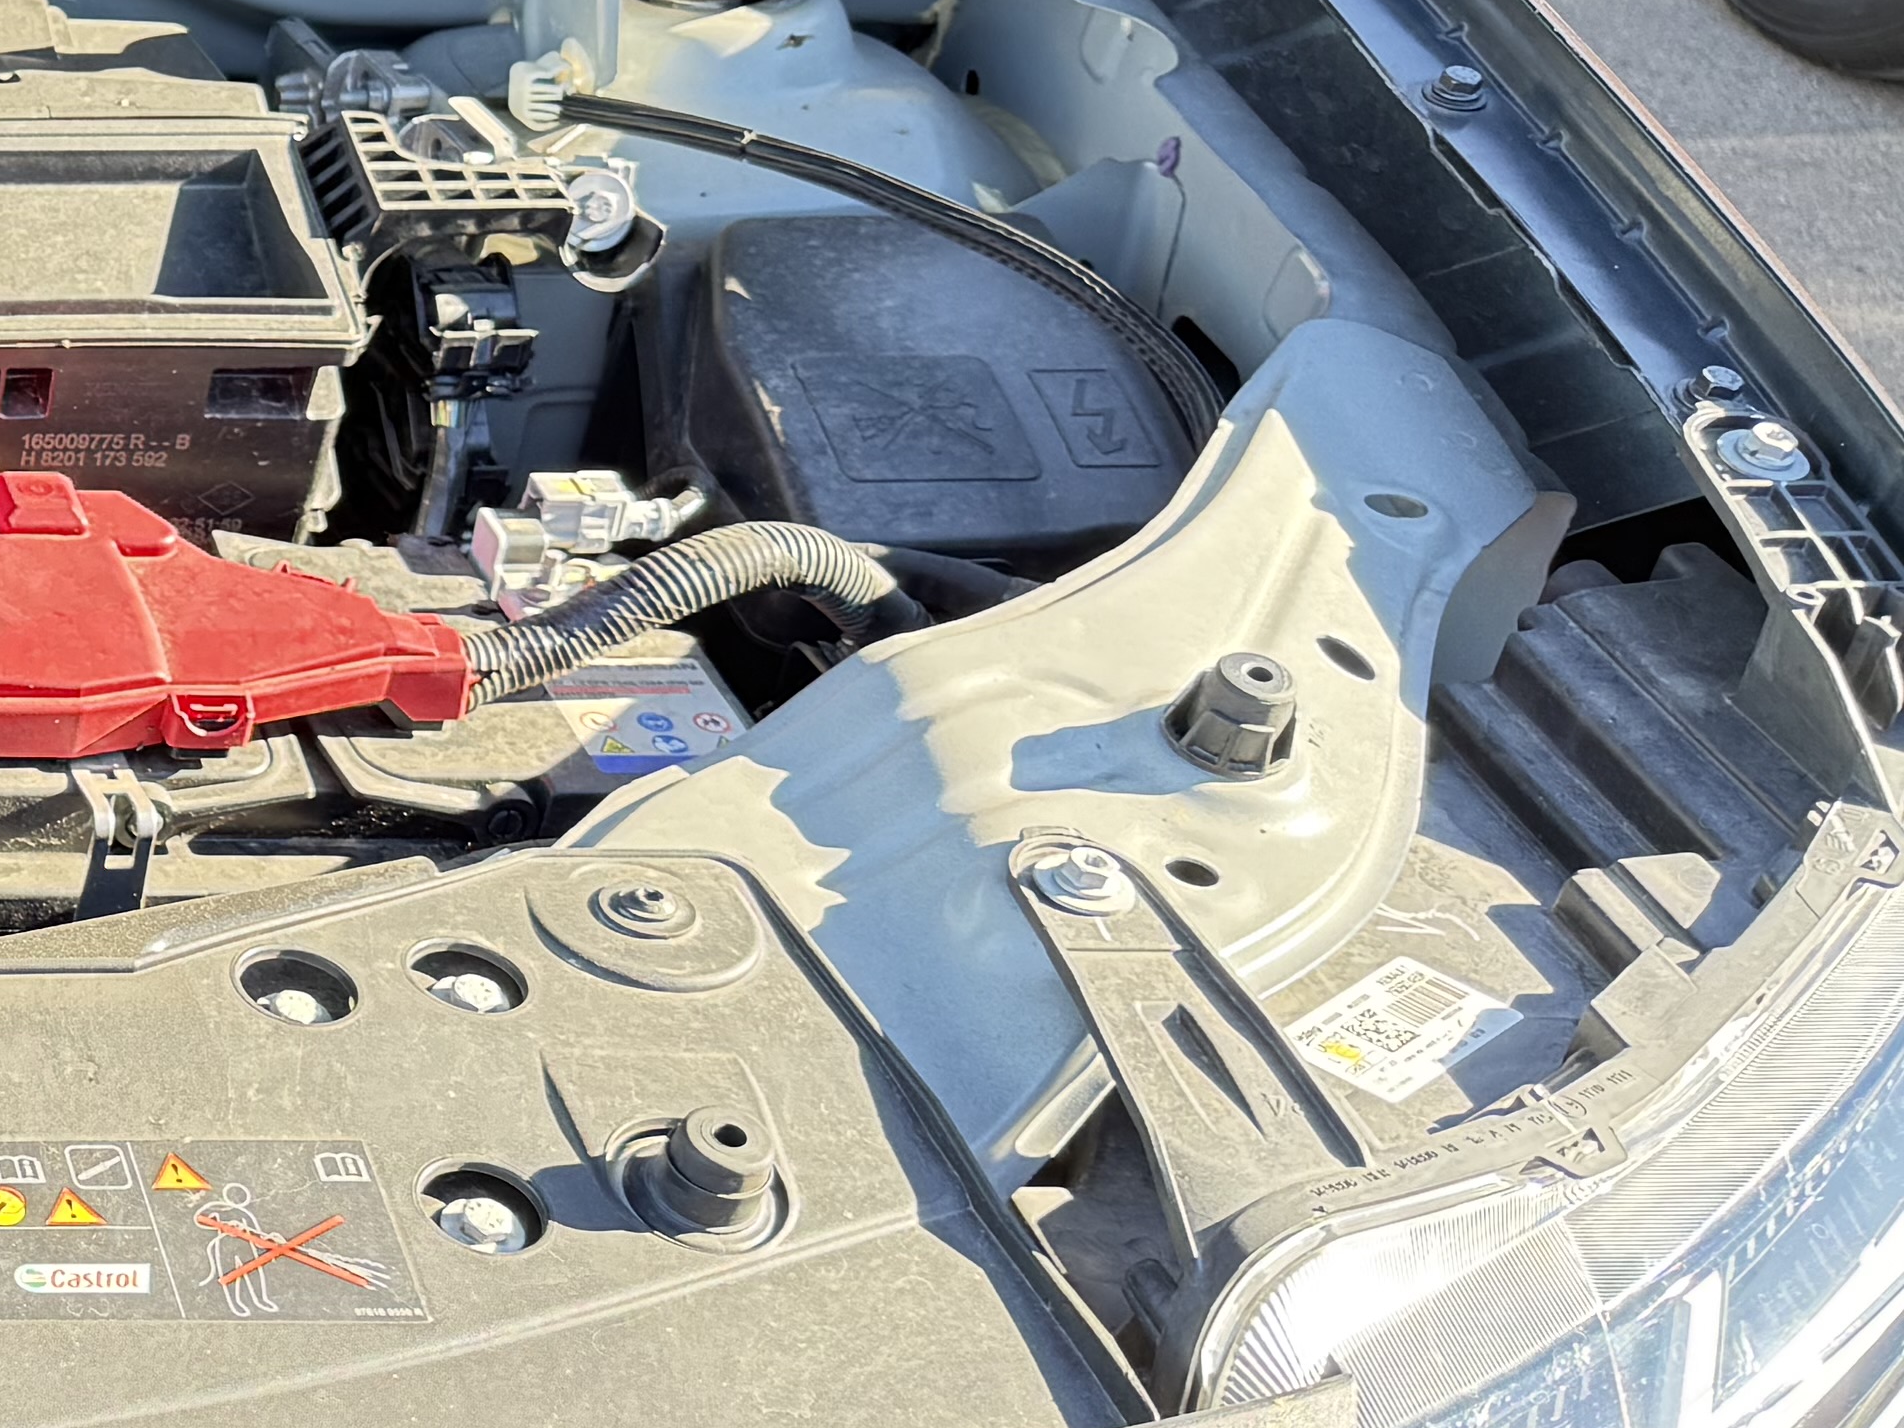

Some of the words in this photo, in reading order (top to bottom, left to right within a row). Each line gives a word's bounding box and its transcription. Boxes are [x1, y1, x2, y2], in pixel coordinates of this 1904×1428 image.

[21, 433, 125, 450] 165009775
[129, 433, 146, 449] R
[175, 433, 191, 450] B
[20, 450, 36, 467] H
[41, 450, 86, 467] 8201
[93, 450, 127, 467] 173
[131, 450, 169, 468] 592
[50, 1268, 140, 1289] Castrol
